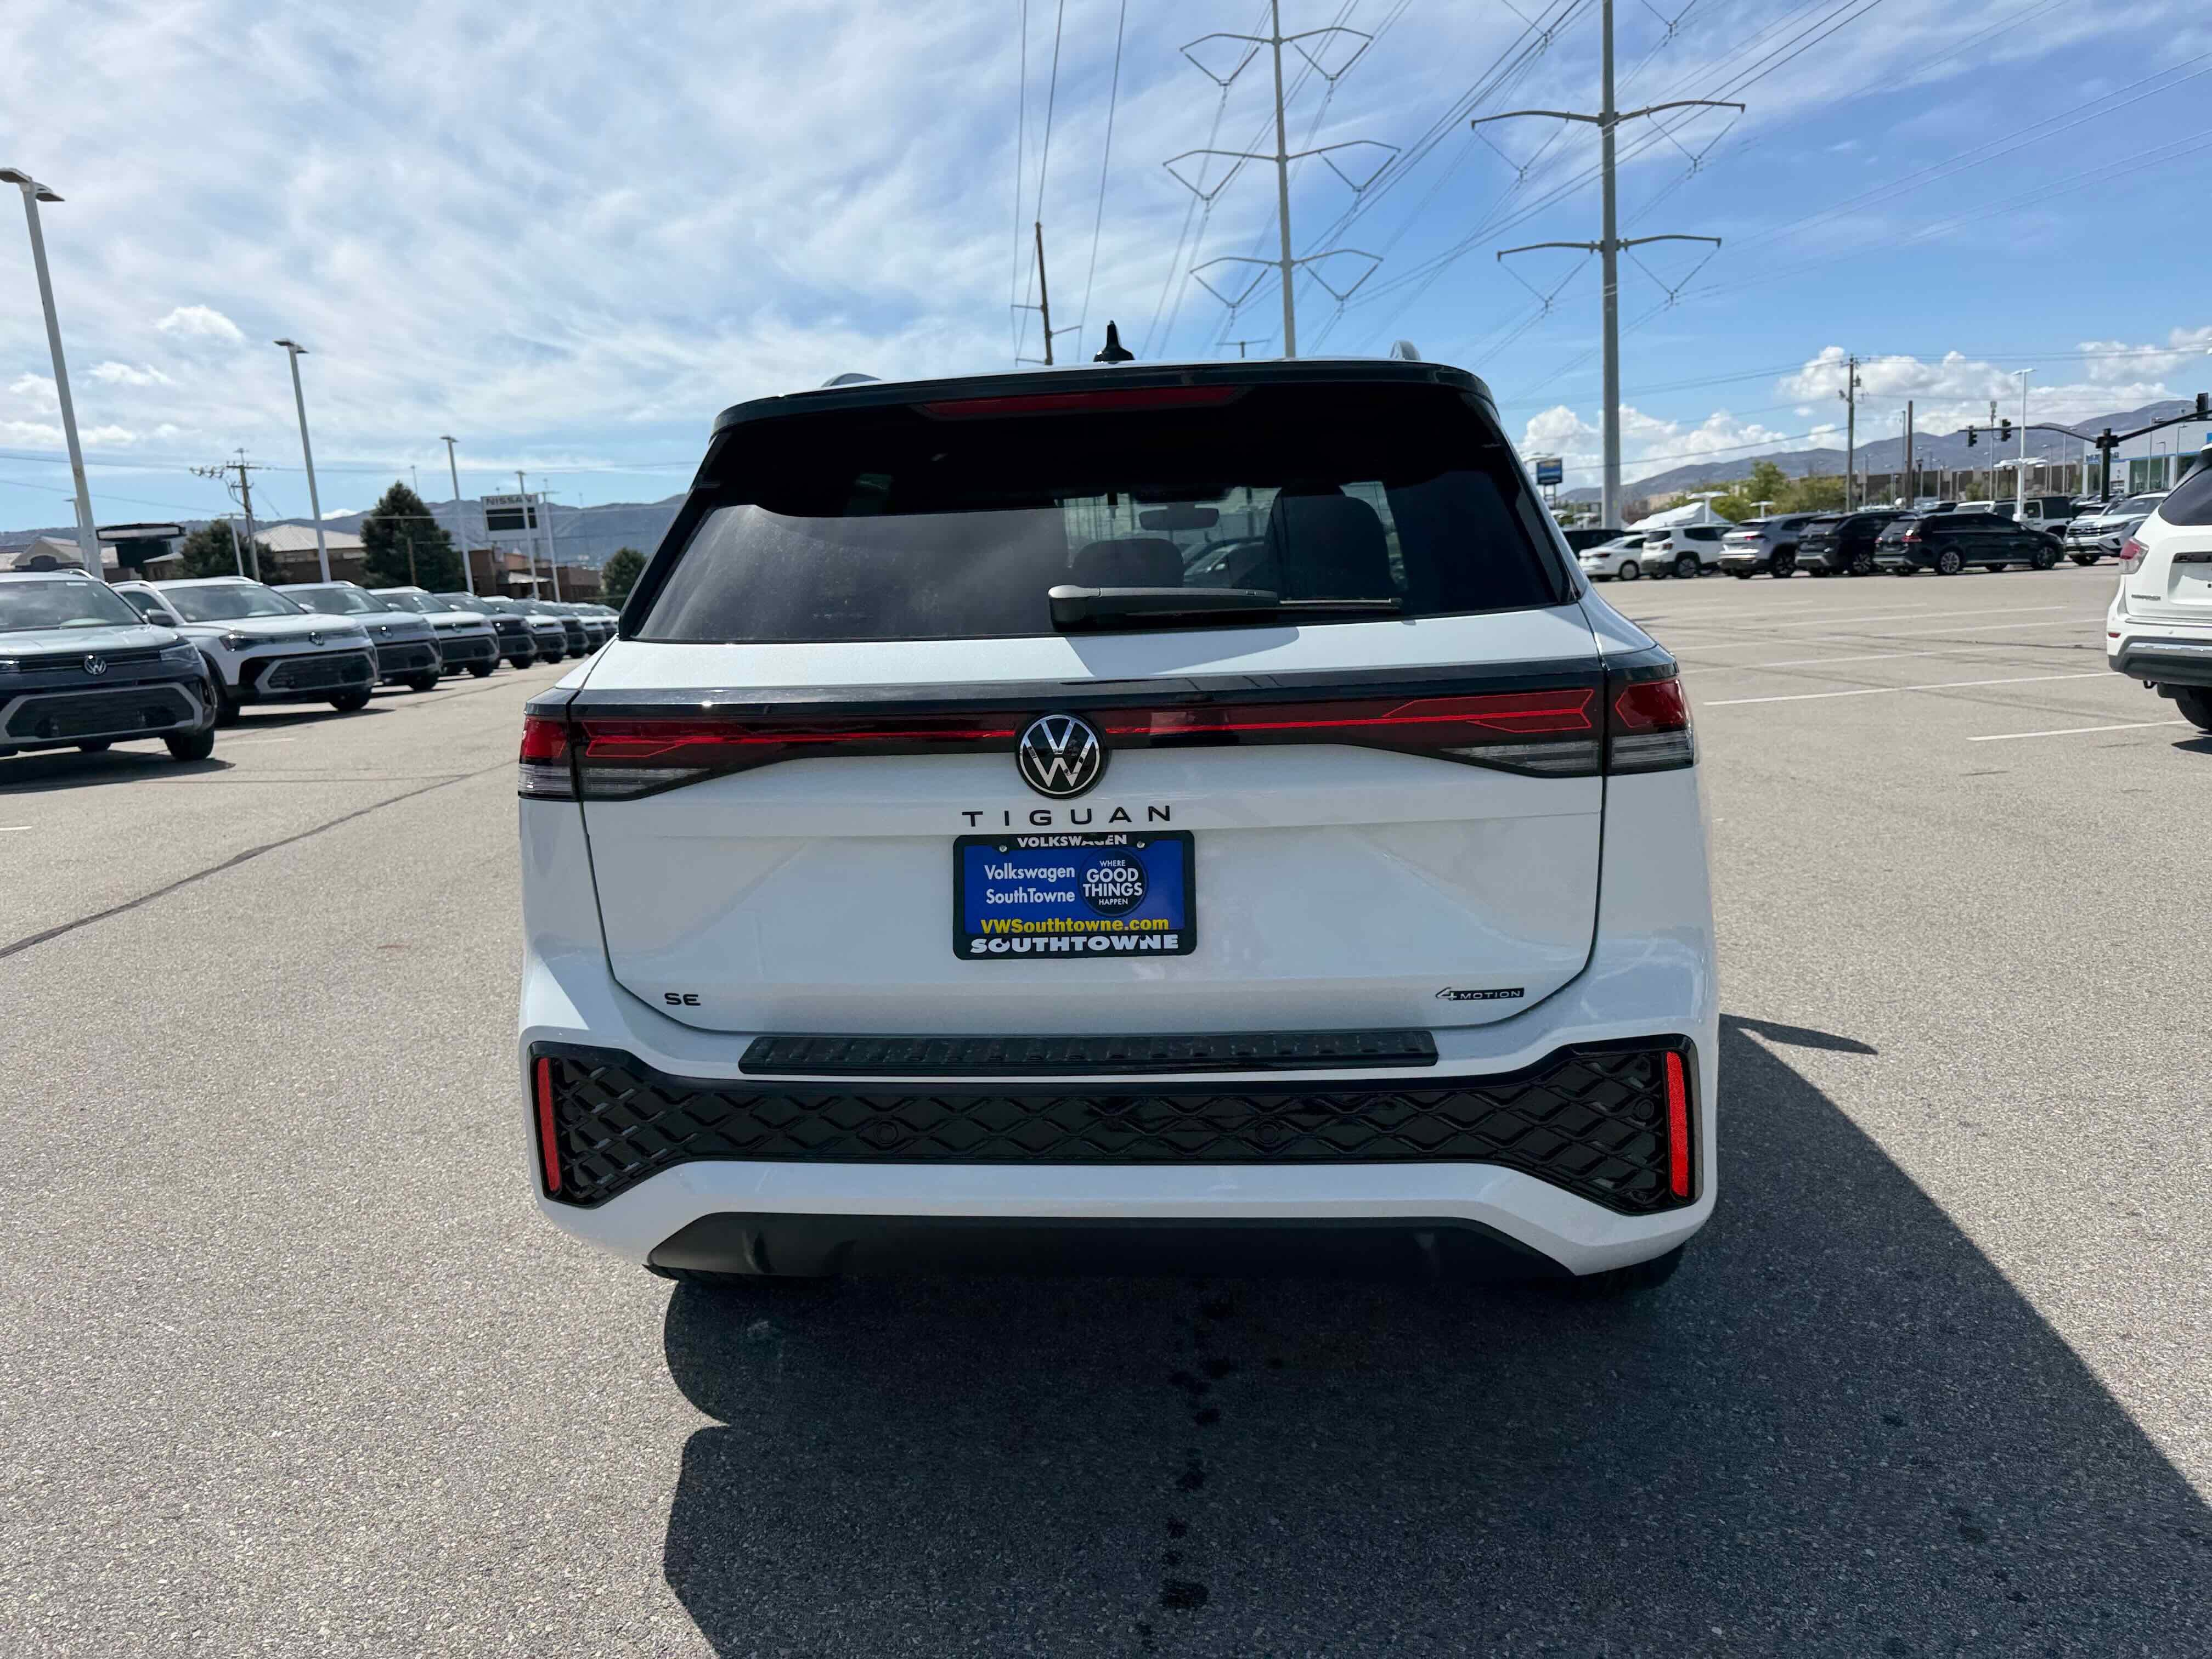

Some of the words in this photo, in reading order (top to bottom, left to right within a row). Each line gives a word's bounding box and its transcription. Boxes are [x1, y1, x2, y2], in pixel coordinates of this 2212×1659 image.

[962, 805, 1171, 827] TIGUAN
[984, 862, 1075, 883] Volkswagen
[1086, 867, 1139, 883] GOOD
[986, 886, 1075, 904] SouthTowne
[1082, 882, 1143, 898] THINGS
[1098, 898, 1128, 906] HAPPEN
[980, 917, 1170, 934] VWSouthtowne.com
[969, 934, 1179, 954] SOUTHTOWNE
[664, 992, 701, 1006] SE
[1435, 988, 1521, 1001] 4MOTION
